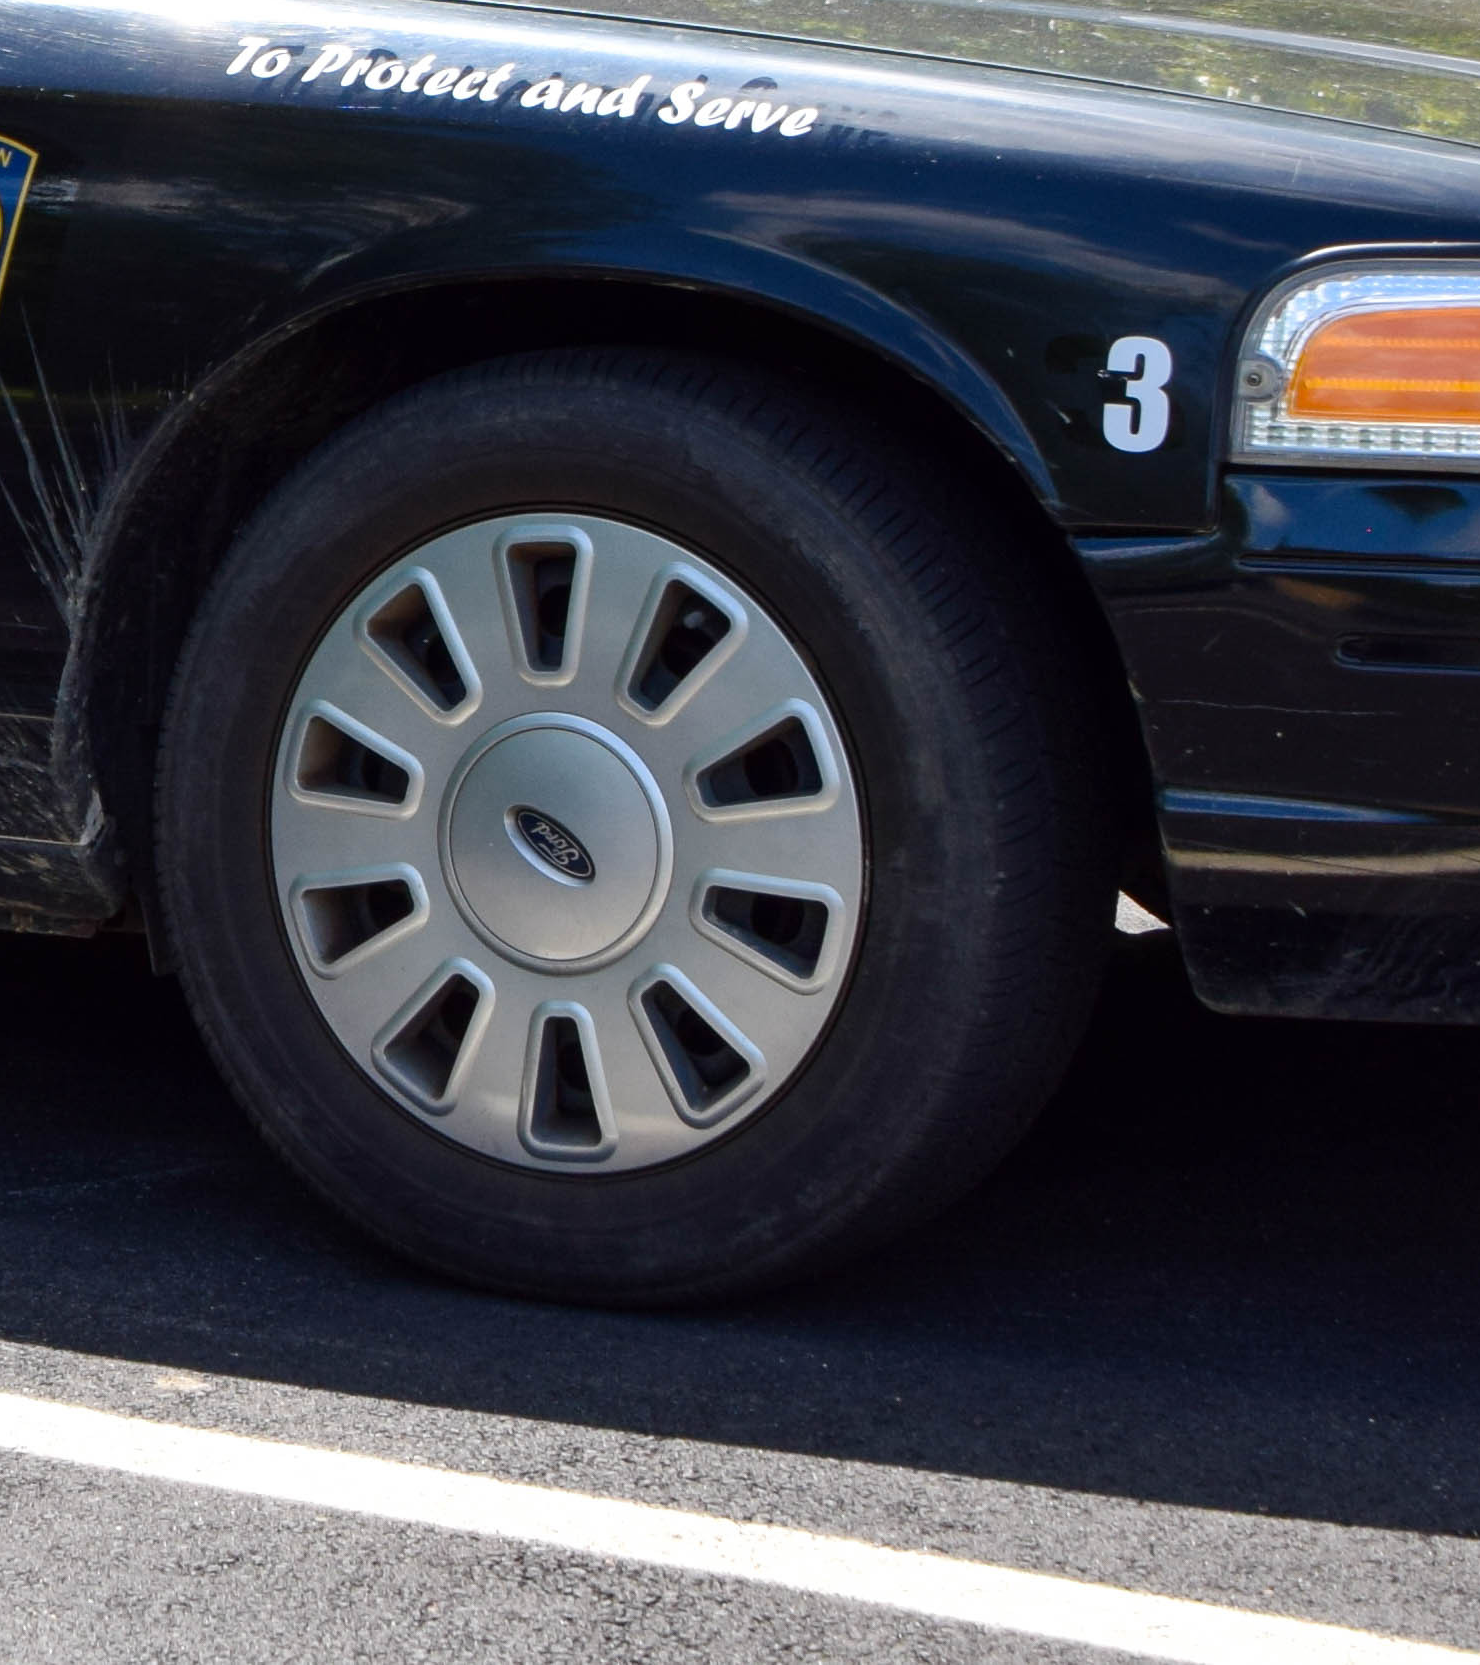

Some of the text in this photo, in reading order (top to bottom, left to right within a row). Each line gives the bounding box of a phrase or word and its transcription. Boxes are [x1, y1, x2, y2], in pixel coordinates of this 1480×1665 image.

[226, 36, 819, 137] To Protect and Serve
[1102, 336, 1173, 453] 3
[530, 821, 580, 865] Ford
